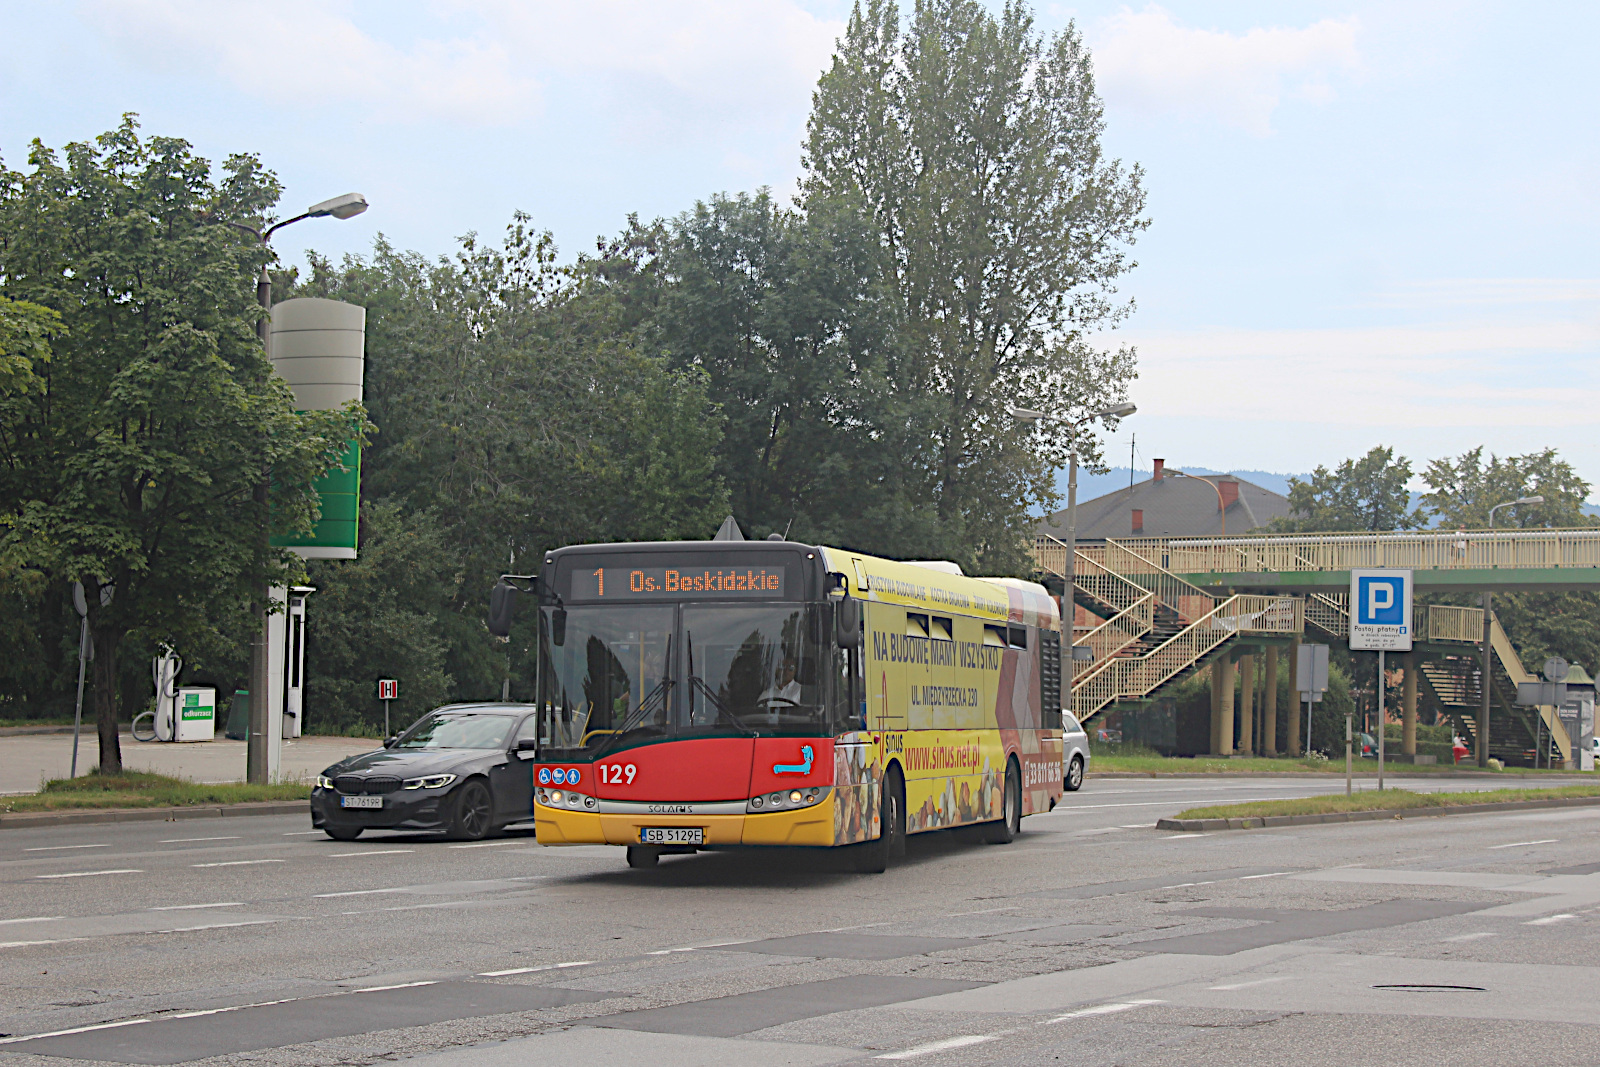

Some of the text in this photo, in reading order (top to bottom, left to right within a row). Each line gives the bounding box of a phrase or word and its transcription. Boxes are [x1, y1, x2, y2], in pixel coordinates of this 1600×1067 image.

[593, 568, 603, 596] 1
[630, 570, 779, 592] Os. Beskidzkie
[1368, 582, 1394, 619] P
[1354, 625, 1399, 634] Postój płatny
[873, 631, 999, 673] NA BUDOWĘ MAMY WSZYSTKO
[385, 682, 392, 696] H
[911, 685, 921, 706] UL.
[968, 687, 978, 707] 230
[184, 710, 212, 718] odkurzacz
[886, 726, 903, 754] sinus
[905, 736, 980, 775] www.sinus.net.pl
[600, 764, 637, 785] 129
[1030, 762, 1037, 785] 33
[346, 797, 354, 807] ST
[648, 805, 693, 813] SOLARIS
[648, 830, 701, 841] SB 5129E
